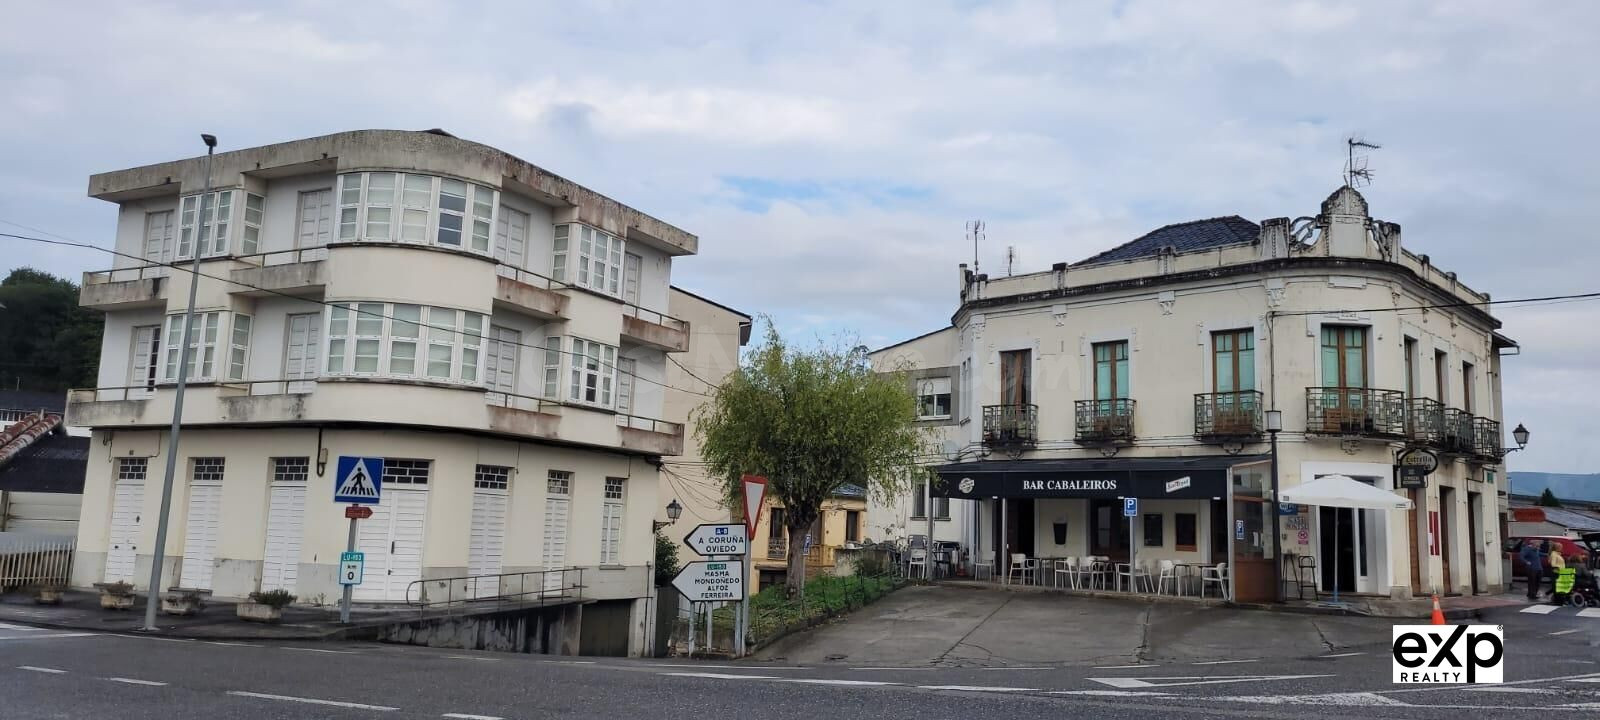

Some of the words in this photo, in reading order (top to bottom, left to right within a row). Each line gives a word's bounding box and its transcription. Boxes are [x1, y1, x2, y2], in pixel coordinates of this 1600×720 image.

[1023, 480, 1044, 490] BAR
[1047, 480, 1117, 490] CABALEIROS
[709, 535, 744, 544] CORUÑA
[347, 571, 354, 580] 0
